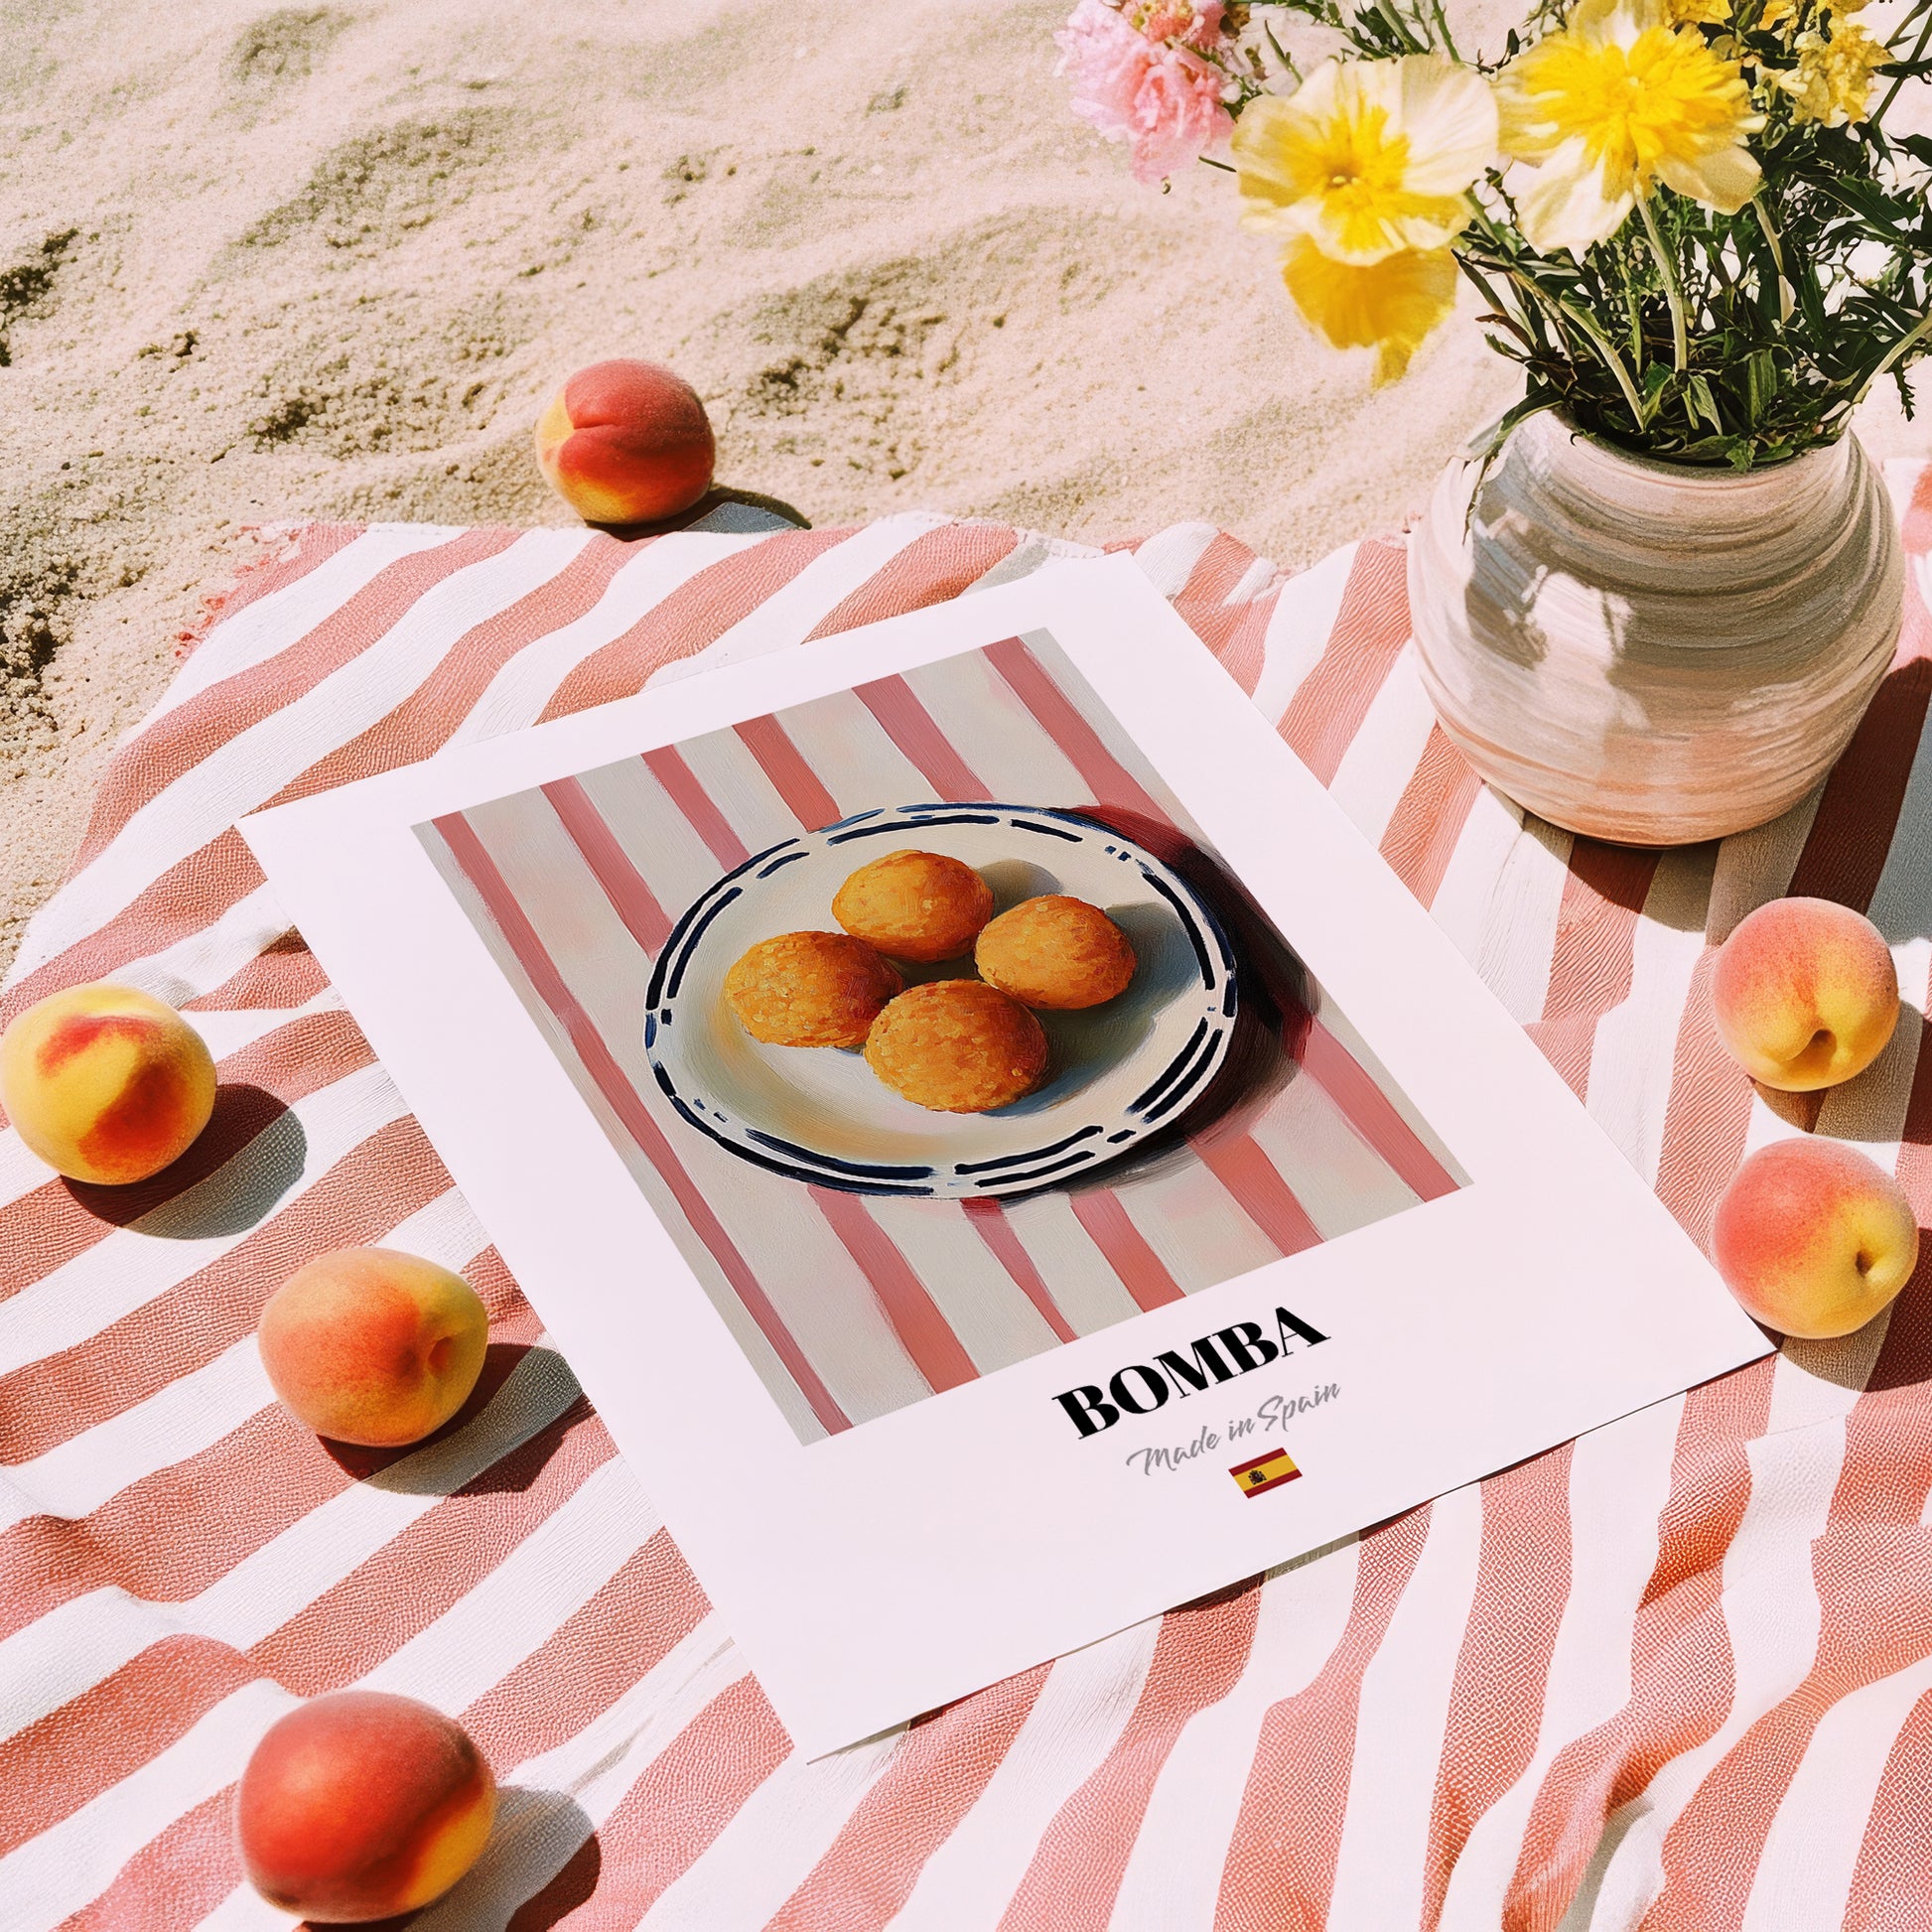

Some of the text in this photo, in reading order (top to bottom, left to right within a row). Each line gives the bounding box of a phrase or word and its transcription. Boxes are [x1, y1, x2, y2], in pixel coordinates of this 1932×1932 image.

[1051, 1307, 1331, 1440] BOMBA
[1126, 1383, 1341, 1476] Made in Spain
